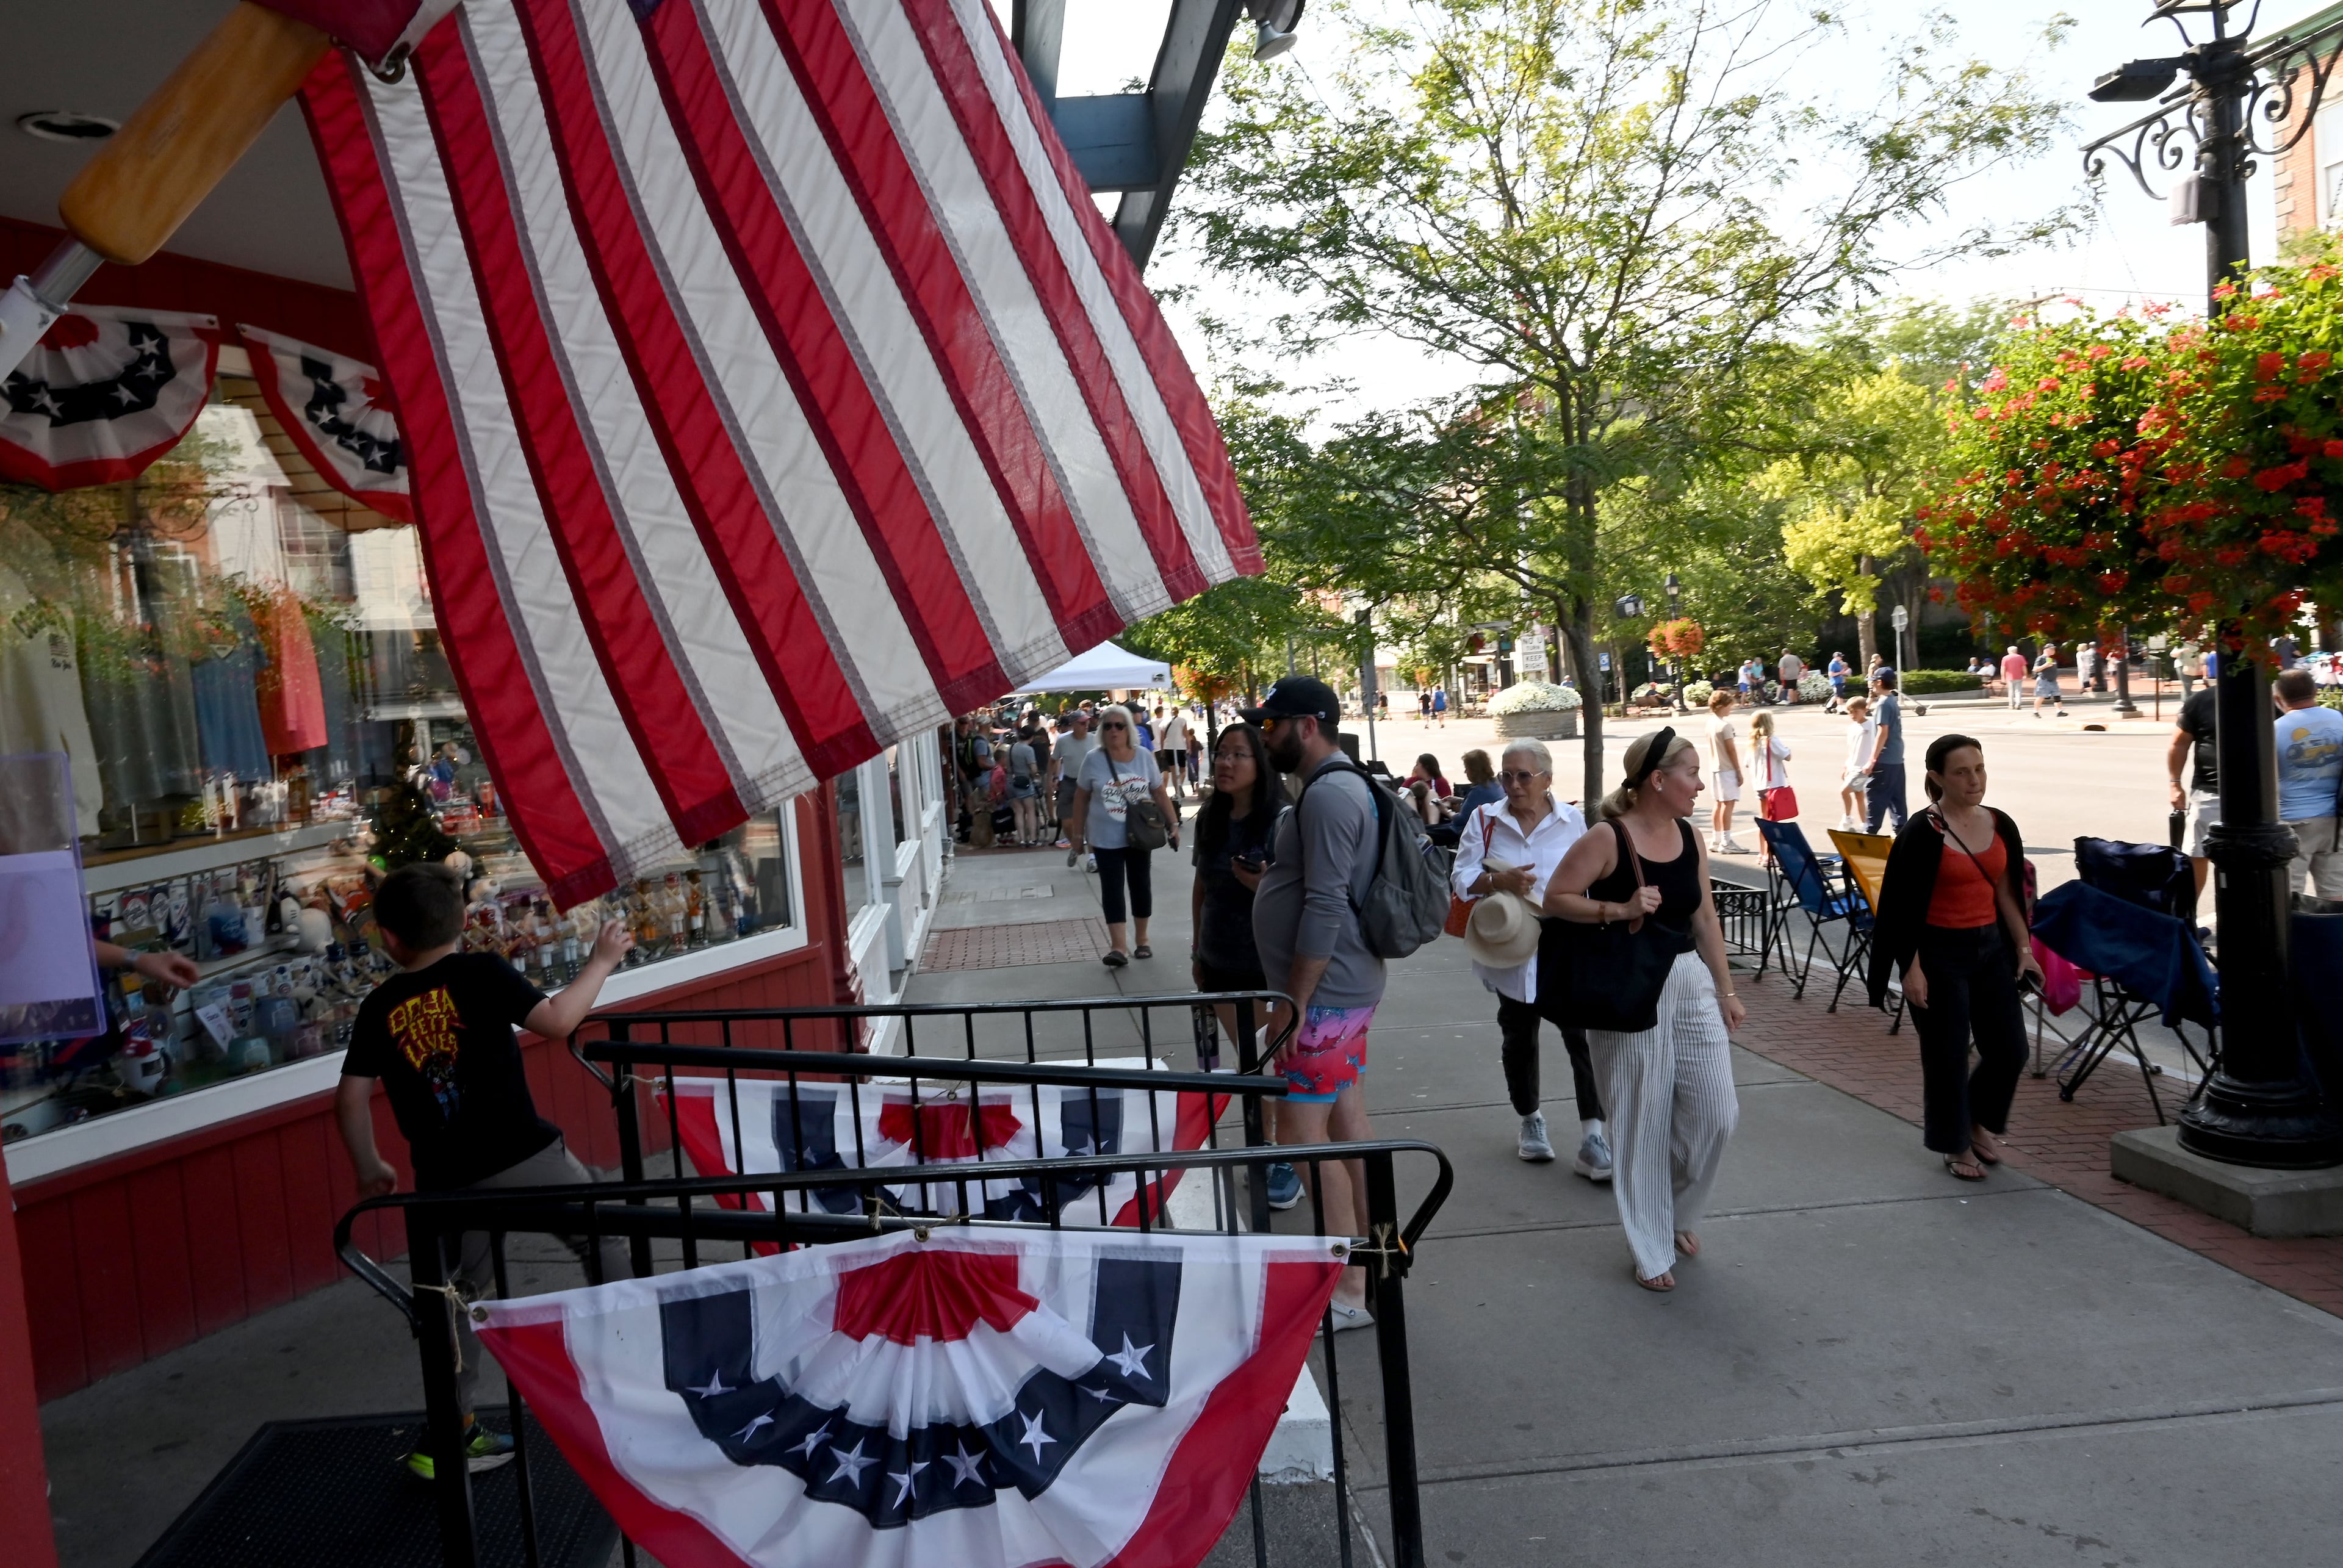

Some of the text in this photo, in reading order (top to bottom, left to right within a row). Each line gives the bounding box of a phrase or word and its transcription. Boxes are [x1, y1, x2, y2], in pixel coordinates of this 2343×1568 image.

[1537, 635, 1542, 644] U
[1102, 783, 1148, 799] Baseball
[408, 1014, 450, 1040] FETT
[405, 1032, 459, 1068] LIVES
